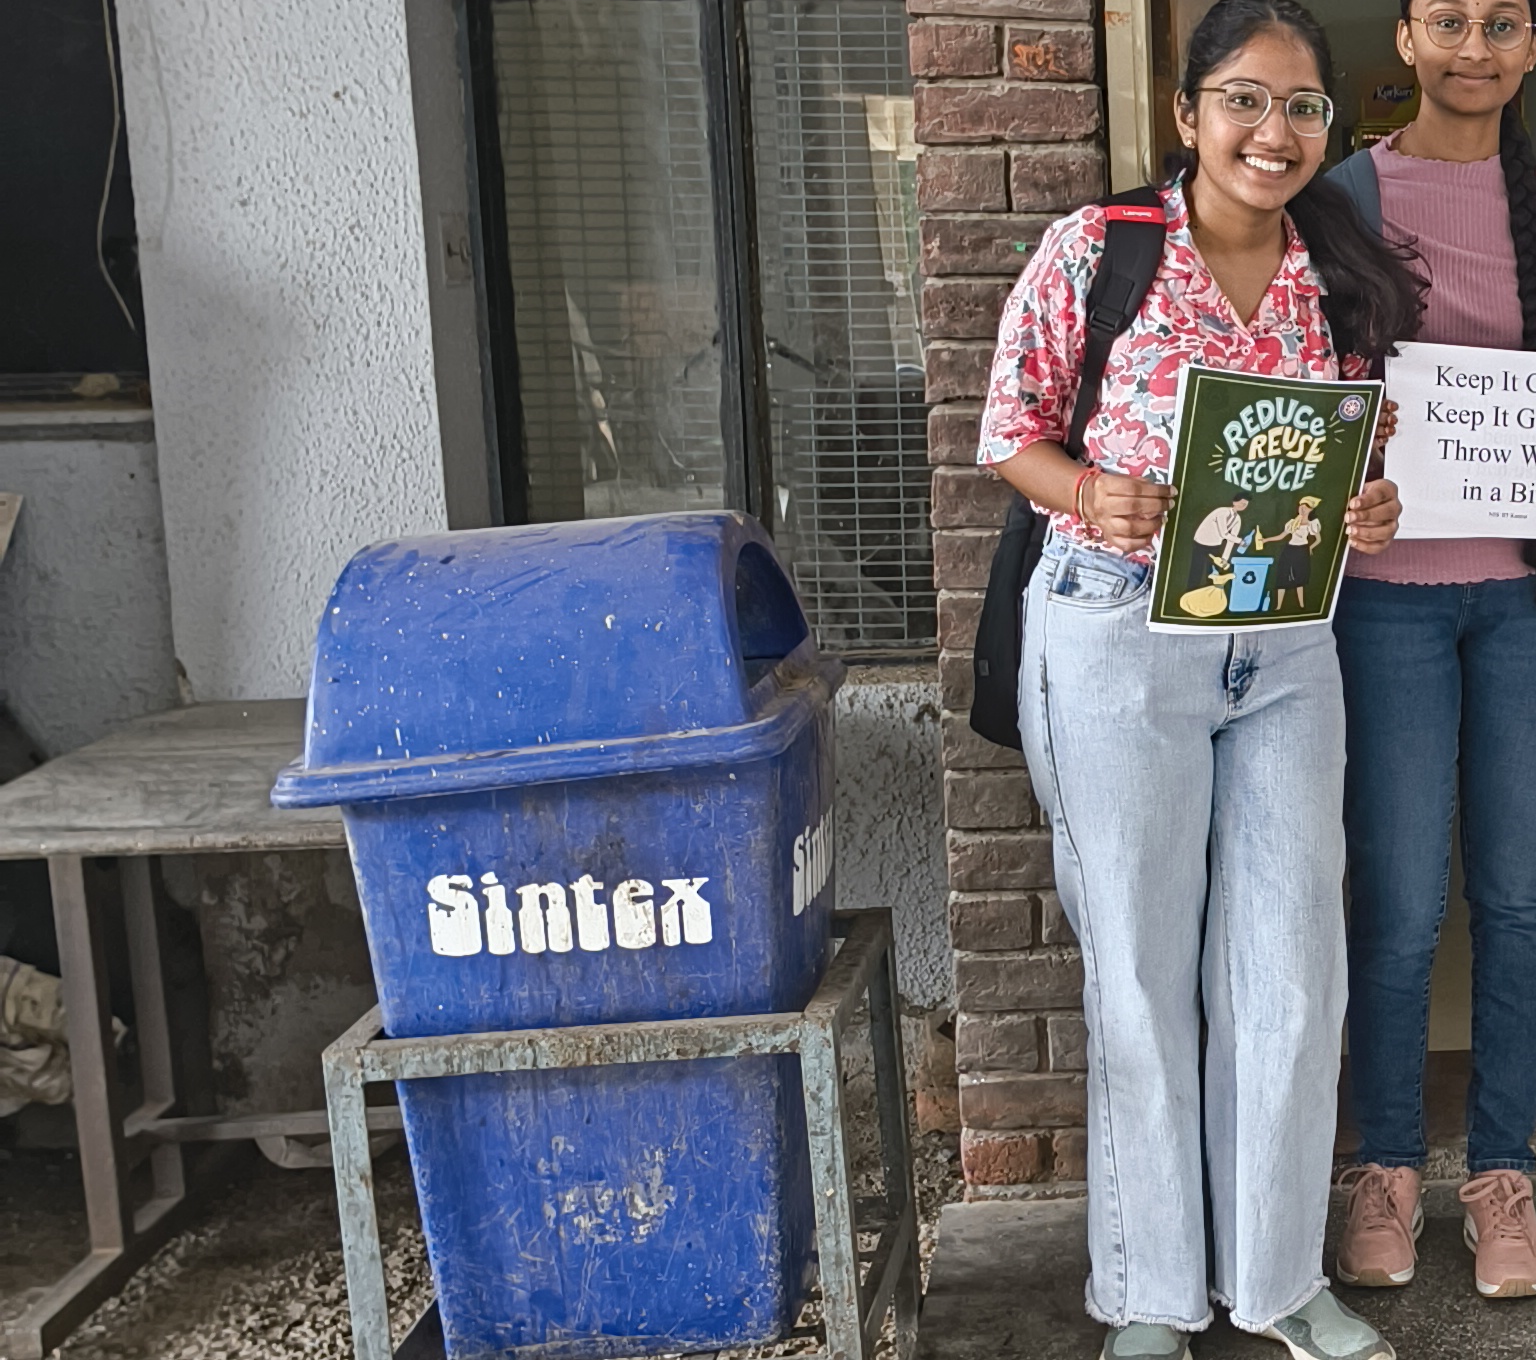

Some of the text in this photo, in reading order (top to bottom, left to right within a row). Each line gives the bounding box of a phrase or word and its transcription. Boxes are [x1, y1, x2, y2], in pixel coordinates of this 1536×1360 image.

[1435, 365, 1494, 391] Keep
[1502, 370, 1520, 392] It
[1425, 400, 1485, 431] Keep
[1492, 405, 1509, 428] It
[1248, 425, 1327, 463] REUSE
[1438, 438, 1512, 463] Throw
[1462, 479, 1482, 501] in
[1490, 486, 1502, 502] a
[427, 871, 713, 956] Sintex
